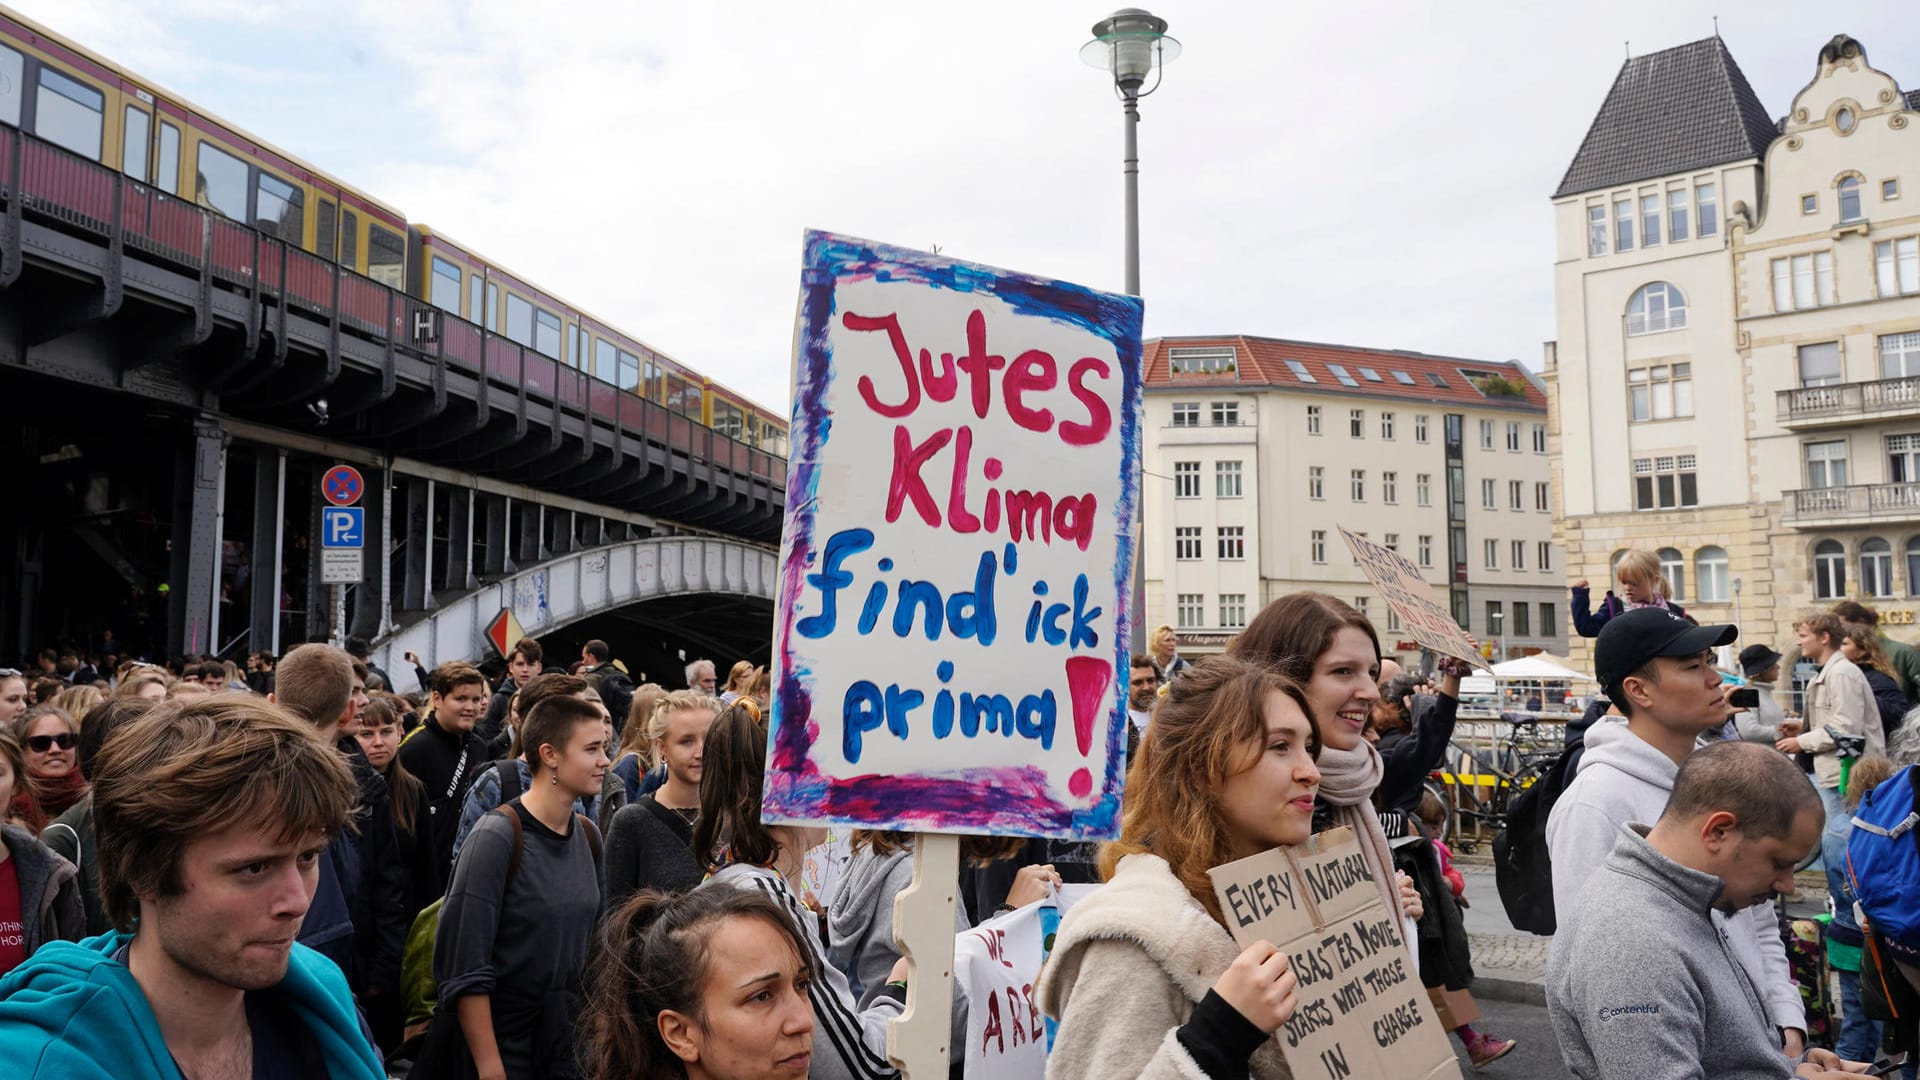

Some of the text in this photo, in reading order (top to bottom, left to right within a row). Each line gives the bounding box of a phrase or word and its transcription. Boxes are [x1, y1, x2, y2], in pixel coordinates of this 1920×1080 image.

[415, 312, 434, 339] H
[842, 309, 1112, 446] Jutes
[332, 512, 355, 542] P
[446, 748, 468, 798] SUPREME
[1225, 853, 1375, 928] EVERY NATURAL
[973, 929, 1014, 968] WE
[1287, 919, 1402, 989] ISASTER MOVIE
[983, 983, 1043, 1057] ARE
[1285, 958, 1408, 1048] STARTS WITH THOSE
[1610, 1004, 1660, 1017] contentful
[1320, 998, 1424, 1080] IN CHARGE
